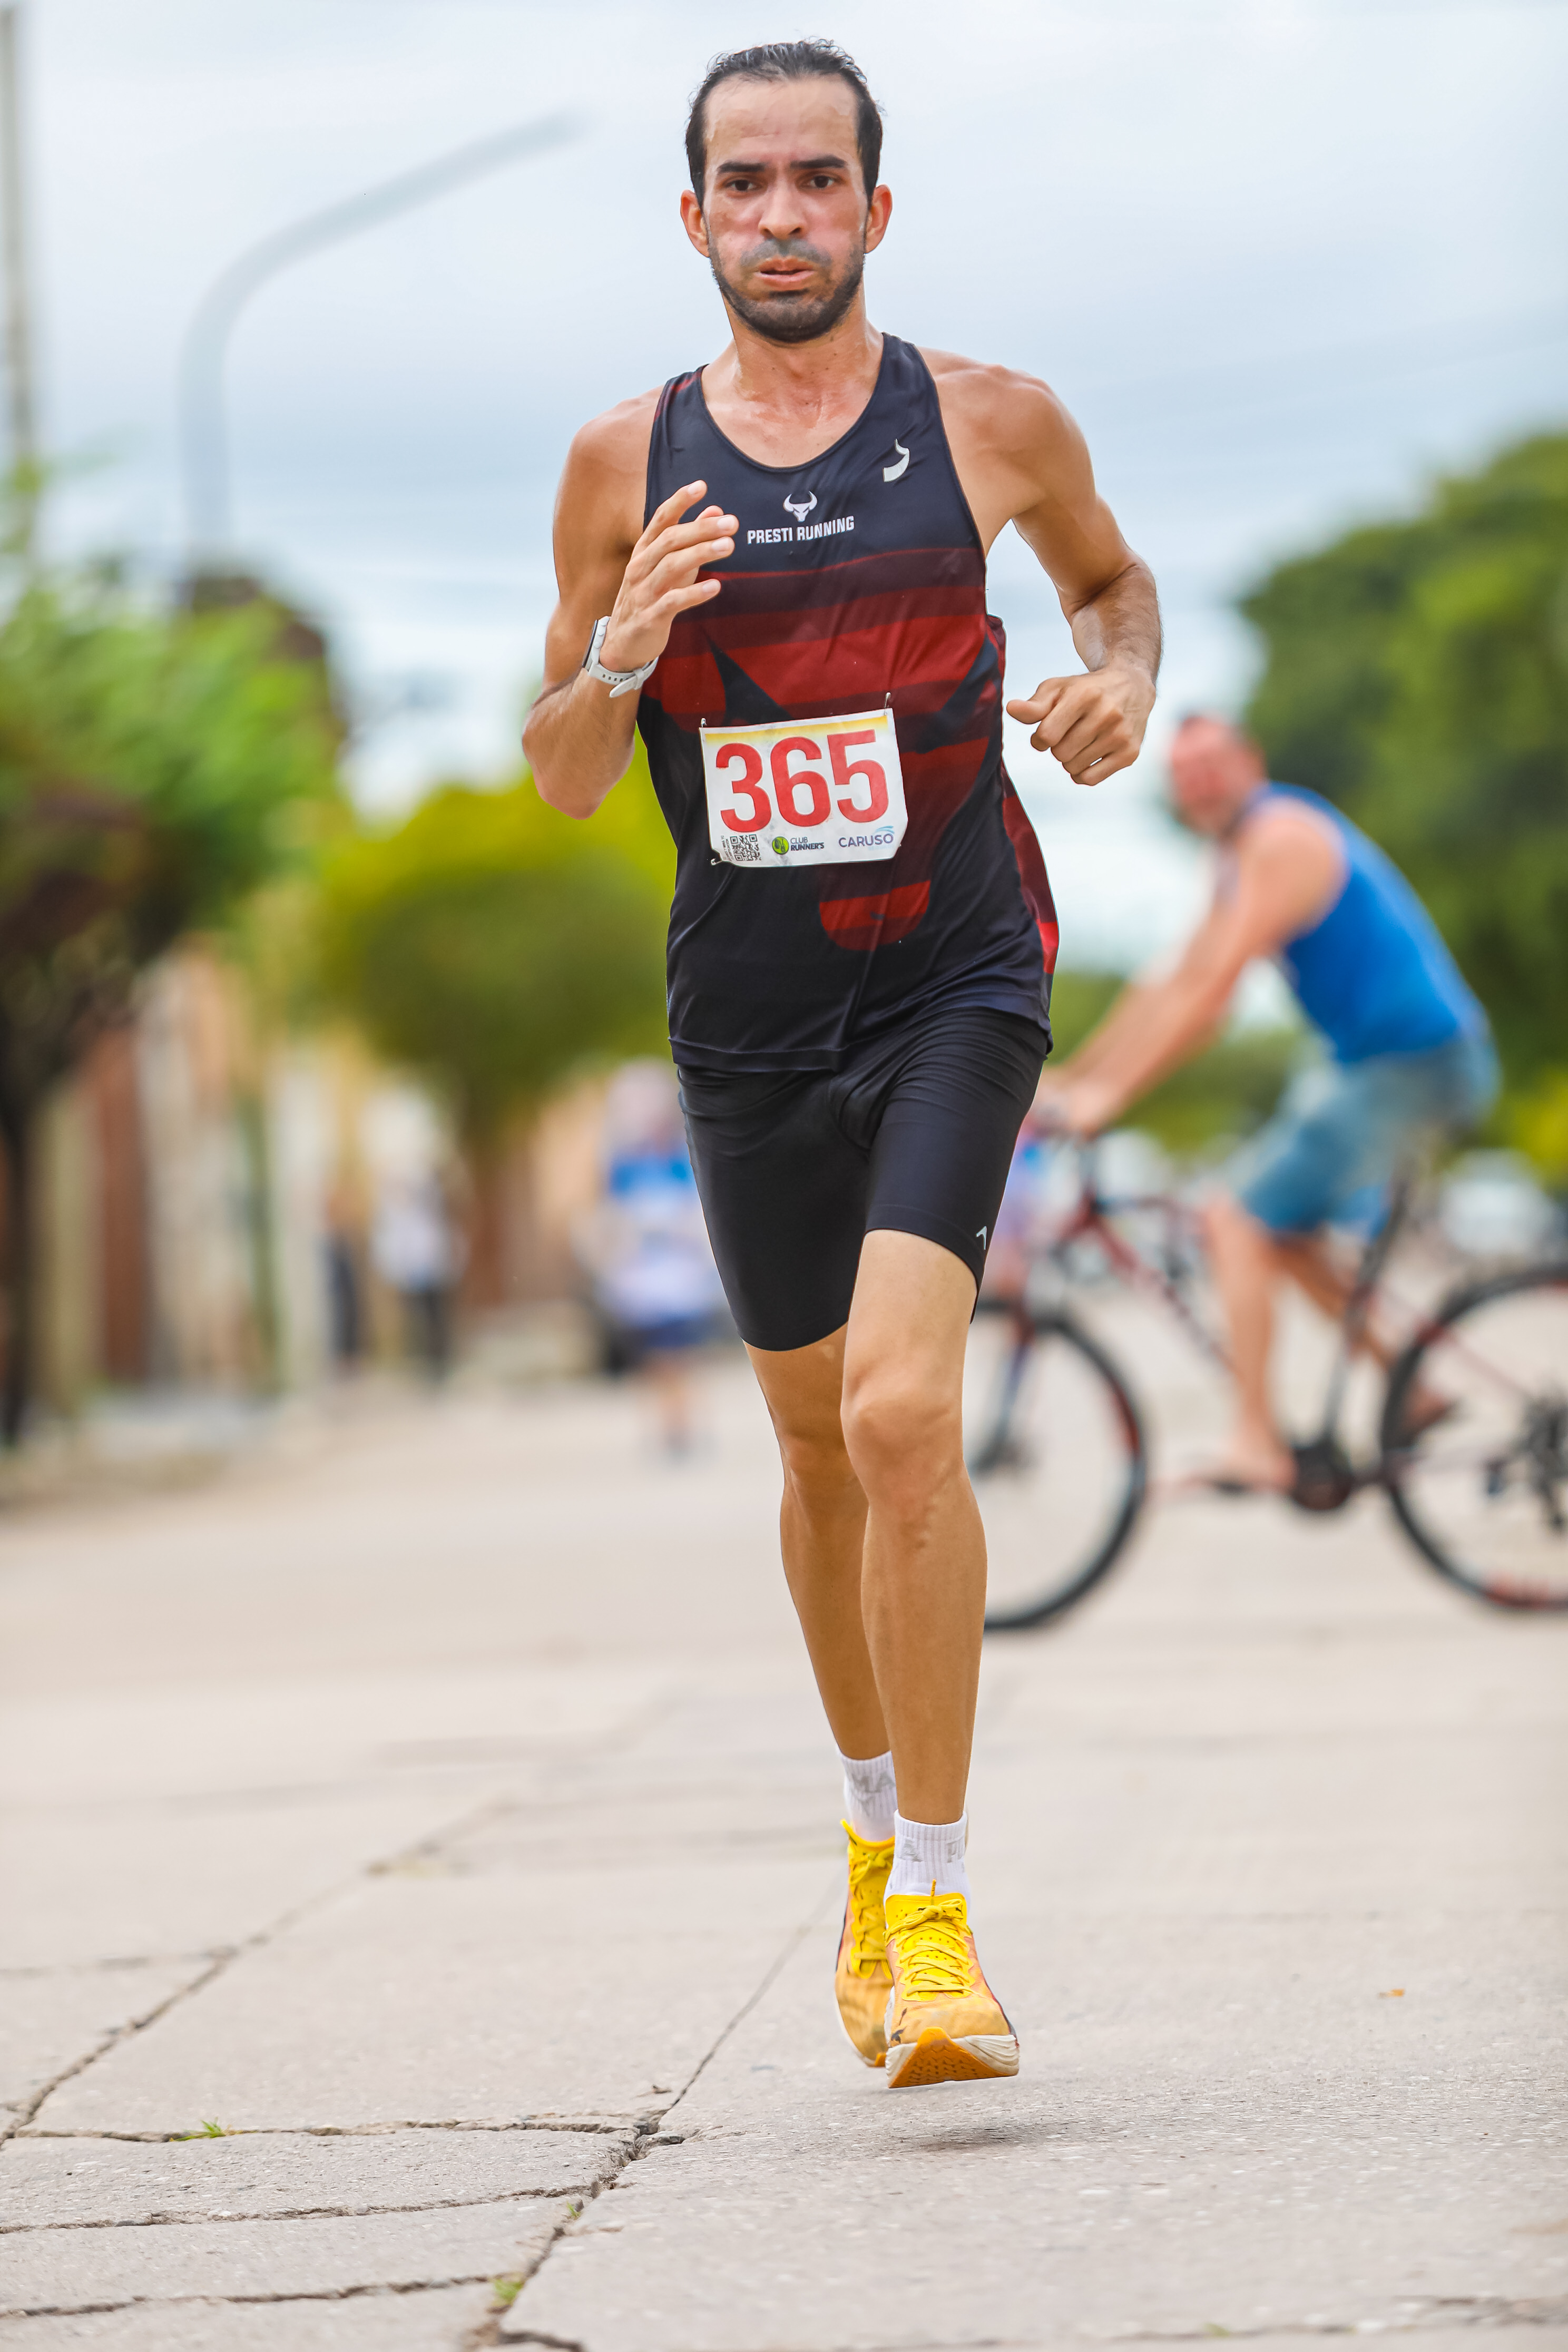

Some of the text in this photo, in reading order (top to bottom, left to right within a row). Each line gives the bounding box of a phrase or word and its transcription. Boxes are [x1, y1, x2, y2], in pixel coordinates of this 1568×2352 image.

[747, 515, 855, 544] PRESTI RUNNING
[716, 729, 889, 833] 365
[838, 833, 894, 848] CARUSO
